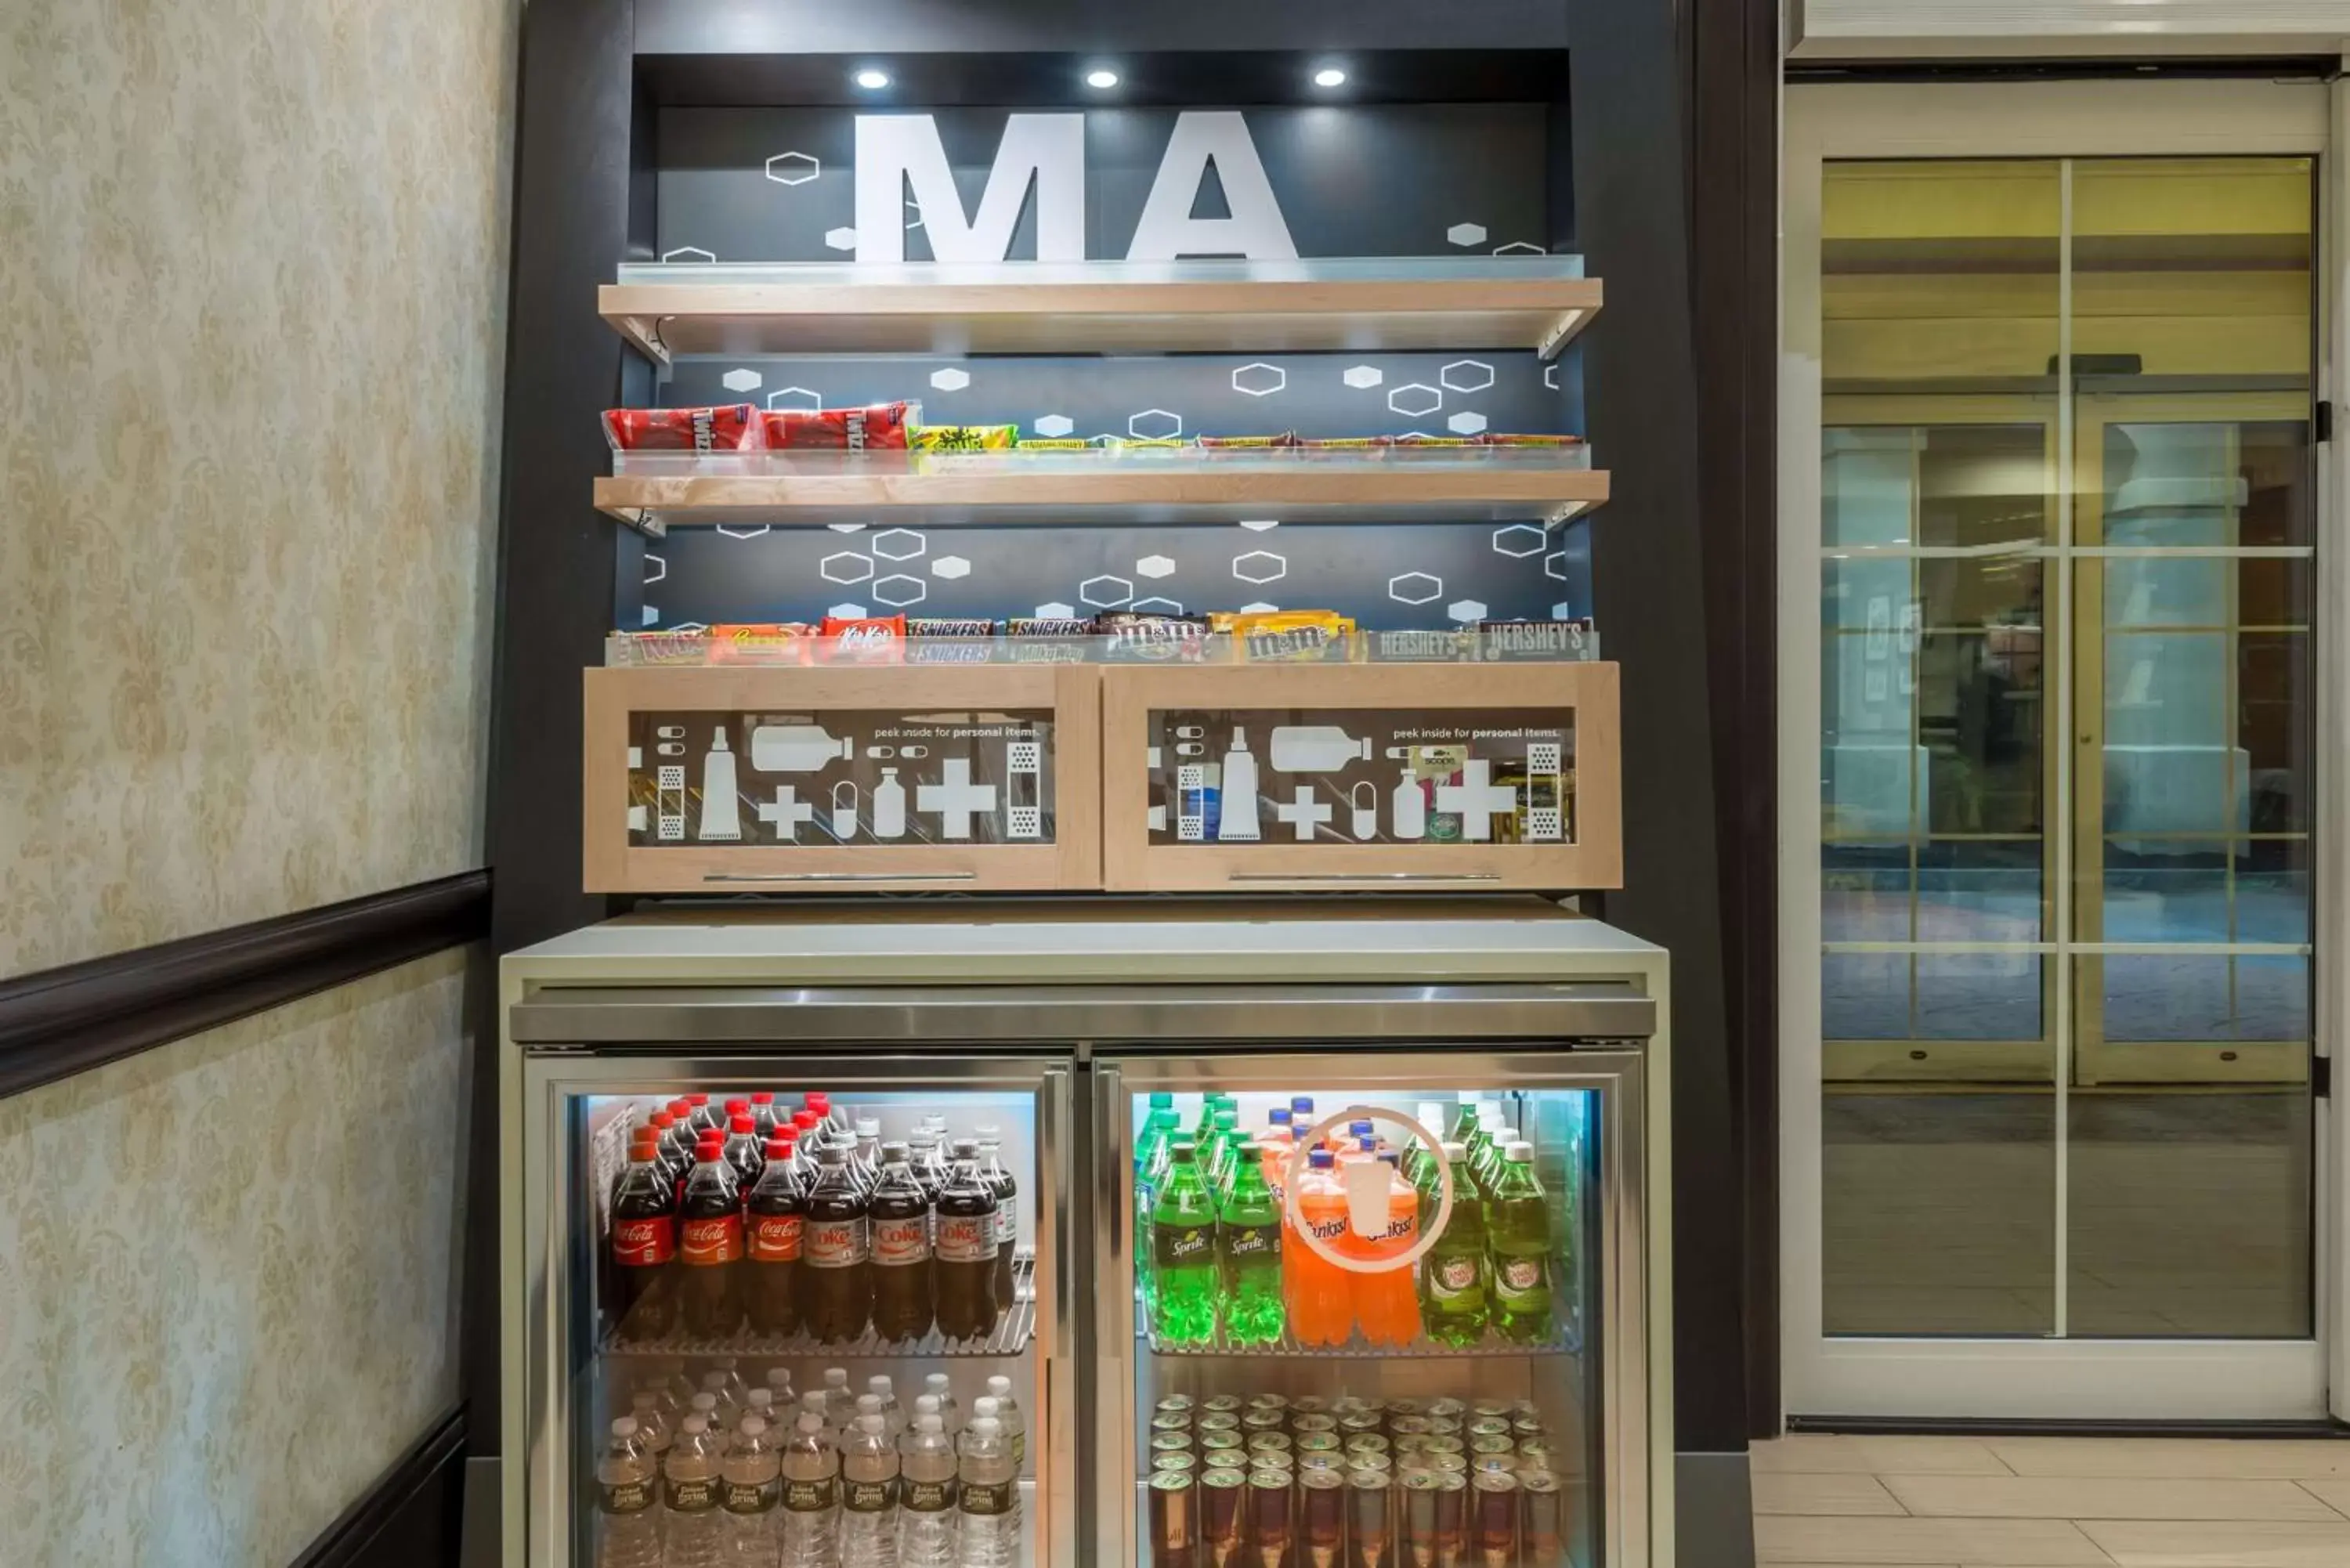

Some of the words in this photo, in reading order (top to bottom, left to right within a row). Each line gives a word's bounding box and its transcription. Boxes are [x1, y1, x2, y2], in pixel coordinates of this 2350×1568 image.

[915, 622, 989, 637] SNICKERS
[1018, 620, 1087, 636] SNICKERS
[1490, 623, 1582, 651] HERSHEY'S
[1380, 633, 1457, 656] HERSHEY'S
[874, 727, 900, 739] peek
[902, 728, 931, 737] inside
[935, 727, 950, 737] for
[953, 727, 1002, 739] personal
[1394, 728, 1419, 739] peek
[1422, 728, 1452, 738] inside
[1455, 728, 1470, 738] for
[1472, 728, 1522, 739] personal
[877, 1224, 922, 1244] Coke
[1173, 1236, 1205, 1256] Sprite
[1231, 1236, 1264, 1256] Sprite
